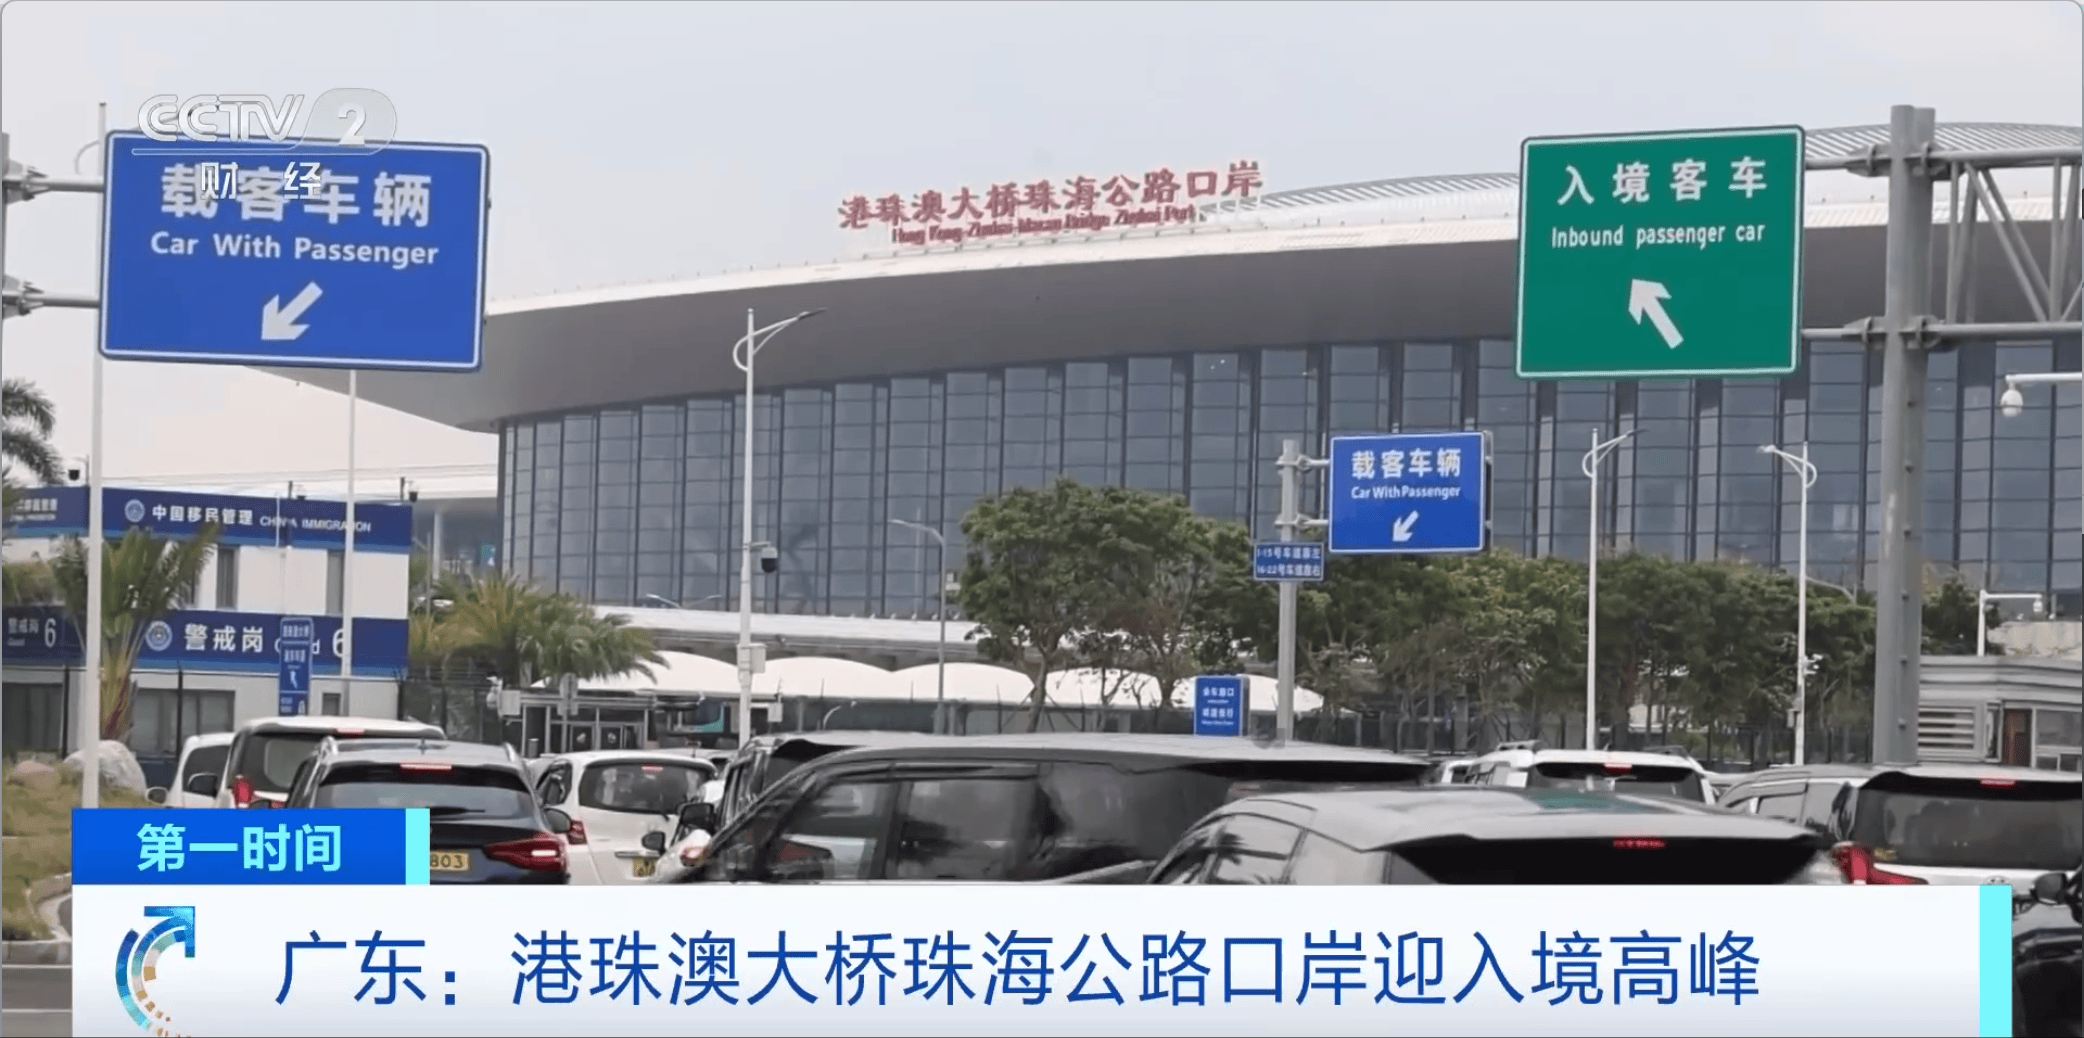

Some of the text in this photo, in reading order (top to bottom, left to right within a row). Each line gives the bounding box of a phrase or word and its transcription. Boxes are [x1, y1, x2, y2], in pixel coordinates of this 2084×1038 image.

[838, 160, 1262, 230] 港珠澳大桥珠海公路口岸
[1557, 155, 1767, 206] 入境客车
[151, 231, 439, 270] Car With Passenger
[1551, 224, 1766, 250] Inbound passenger car
[1351, 447, 1461, 480] 载客车辆
[1351, 484, 1461, 501] Car With Passenger
[152, 505, 253, 526] 中国移民管理
[44, 617, 57, 649] 6
[184, 623, 263, 653] 警戒岗
